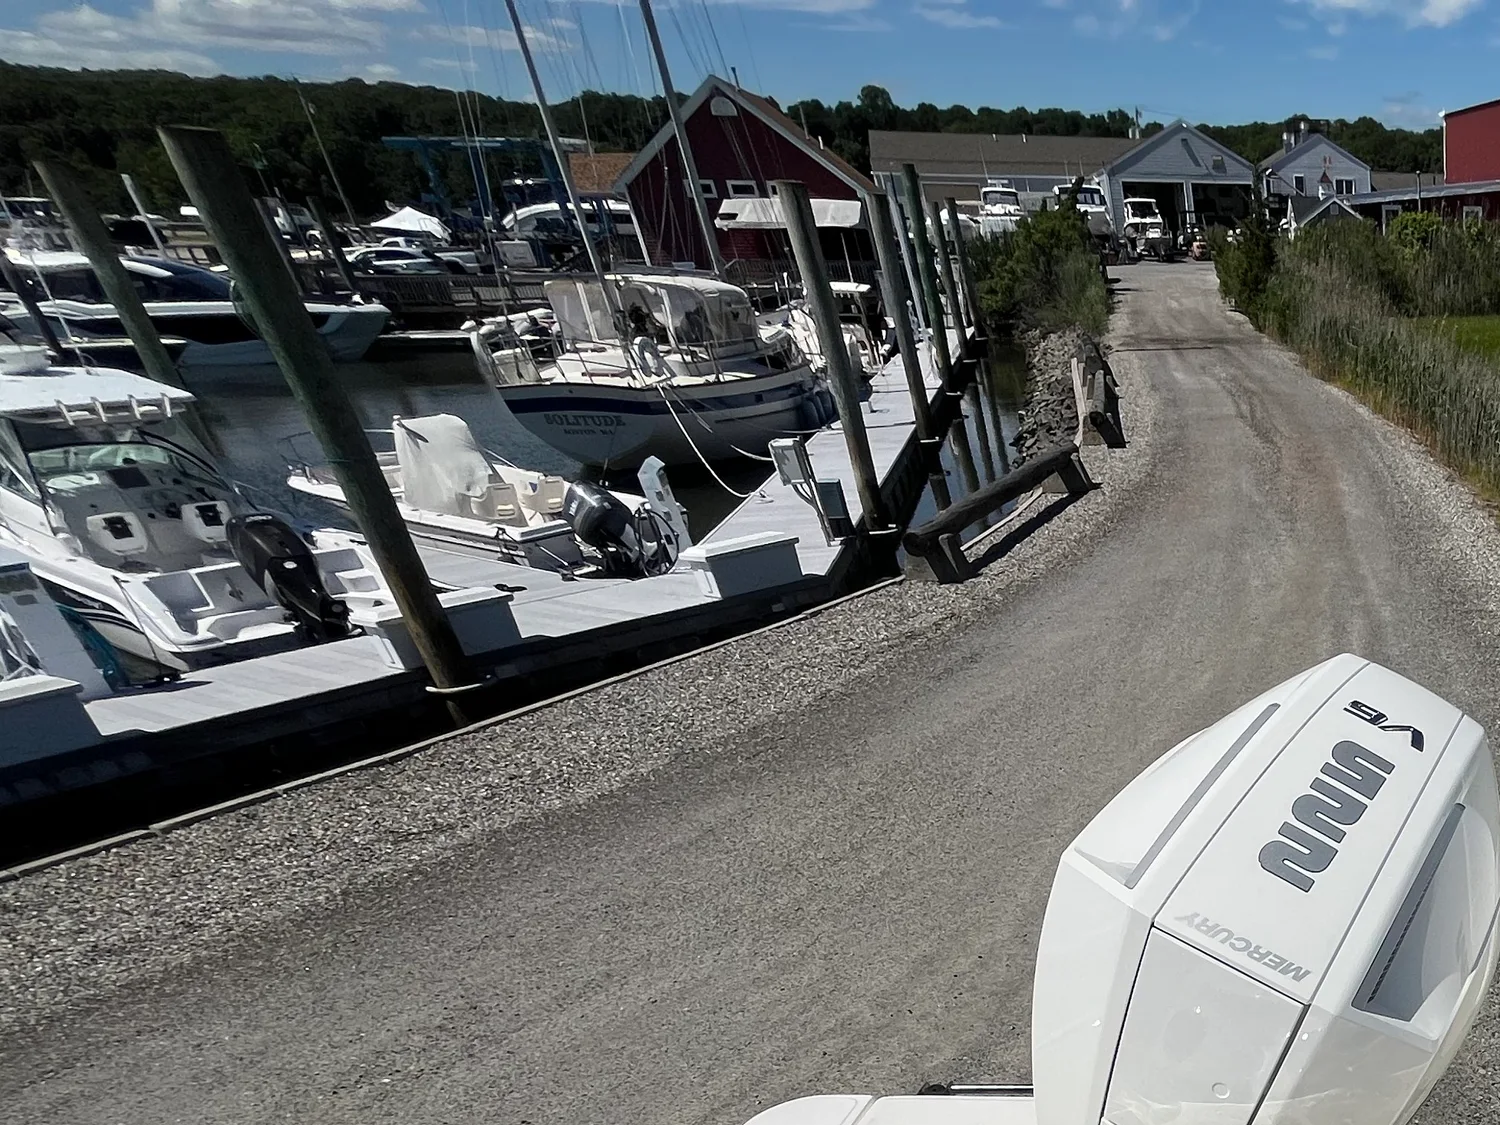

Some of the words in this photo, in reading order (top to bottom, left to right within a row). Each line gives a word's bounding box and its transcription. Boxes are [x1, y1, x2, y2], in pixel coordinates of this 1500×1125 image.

[543, 413, 626, 427] SOLITUDE
[1343, 698, 1425, 753] V6
[1257, 739, 1397, 894] 225
[1175, 911, 1312, 983] MERCURY
